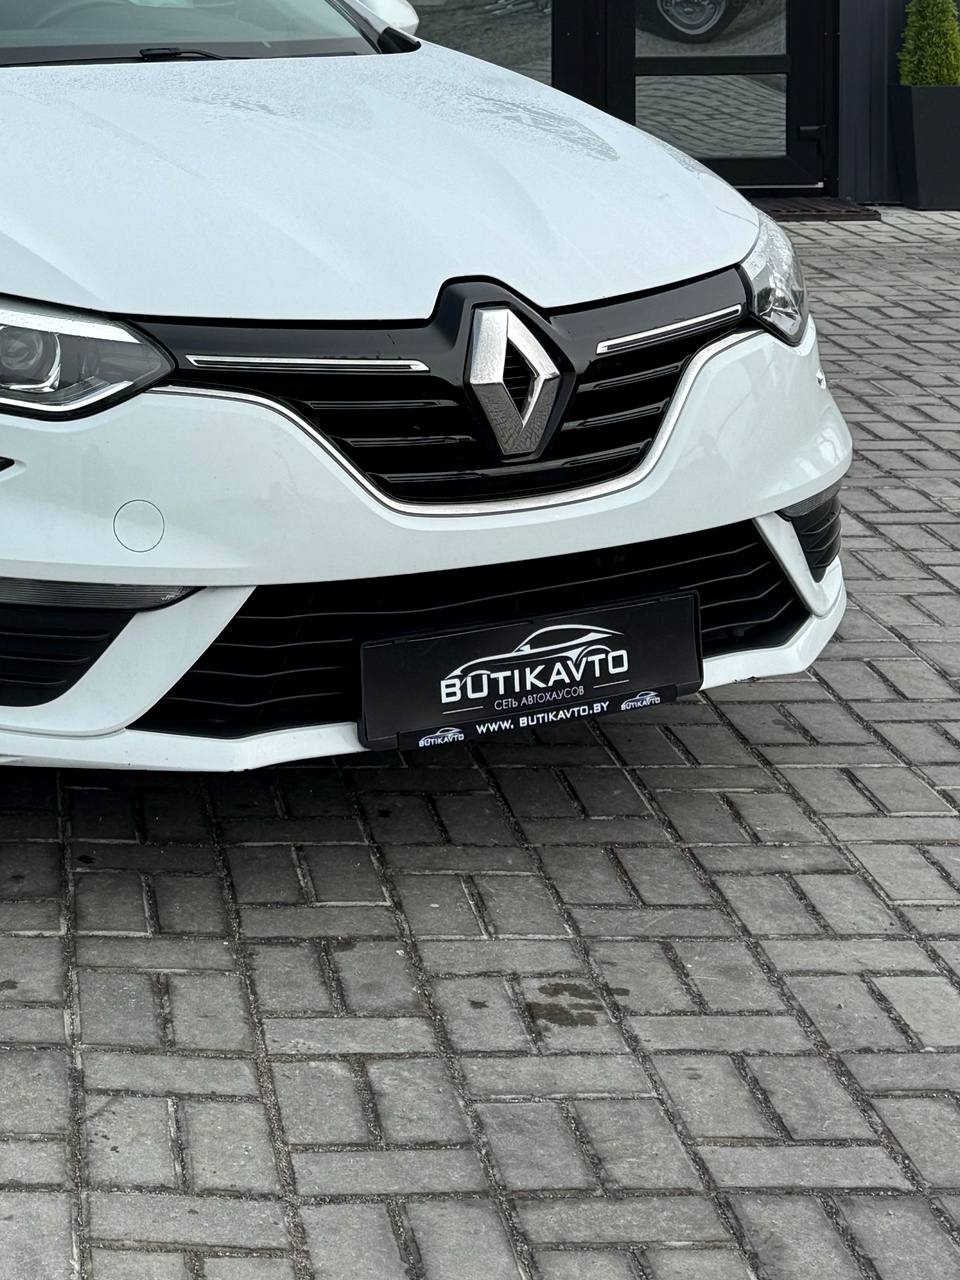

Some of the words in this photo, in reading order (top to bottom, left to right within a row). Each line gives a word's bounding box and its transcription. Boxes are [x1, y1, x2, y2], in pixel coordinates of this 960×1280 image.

[440, 649, 629, 704] BUTIKAVTO
[494, 699, 519, 711] СЕТЬ
[520, 685, 585, 706] АВТОХАУСОВ
[620, 696, 661, 711] BUTIKAVTO
[476, 719, 515, 735] WWW.
[519, 701, 610, 728] BUTIKAVTO.BY
[418, 733, 465, 747] BUTIKAVTO
